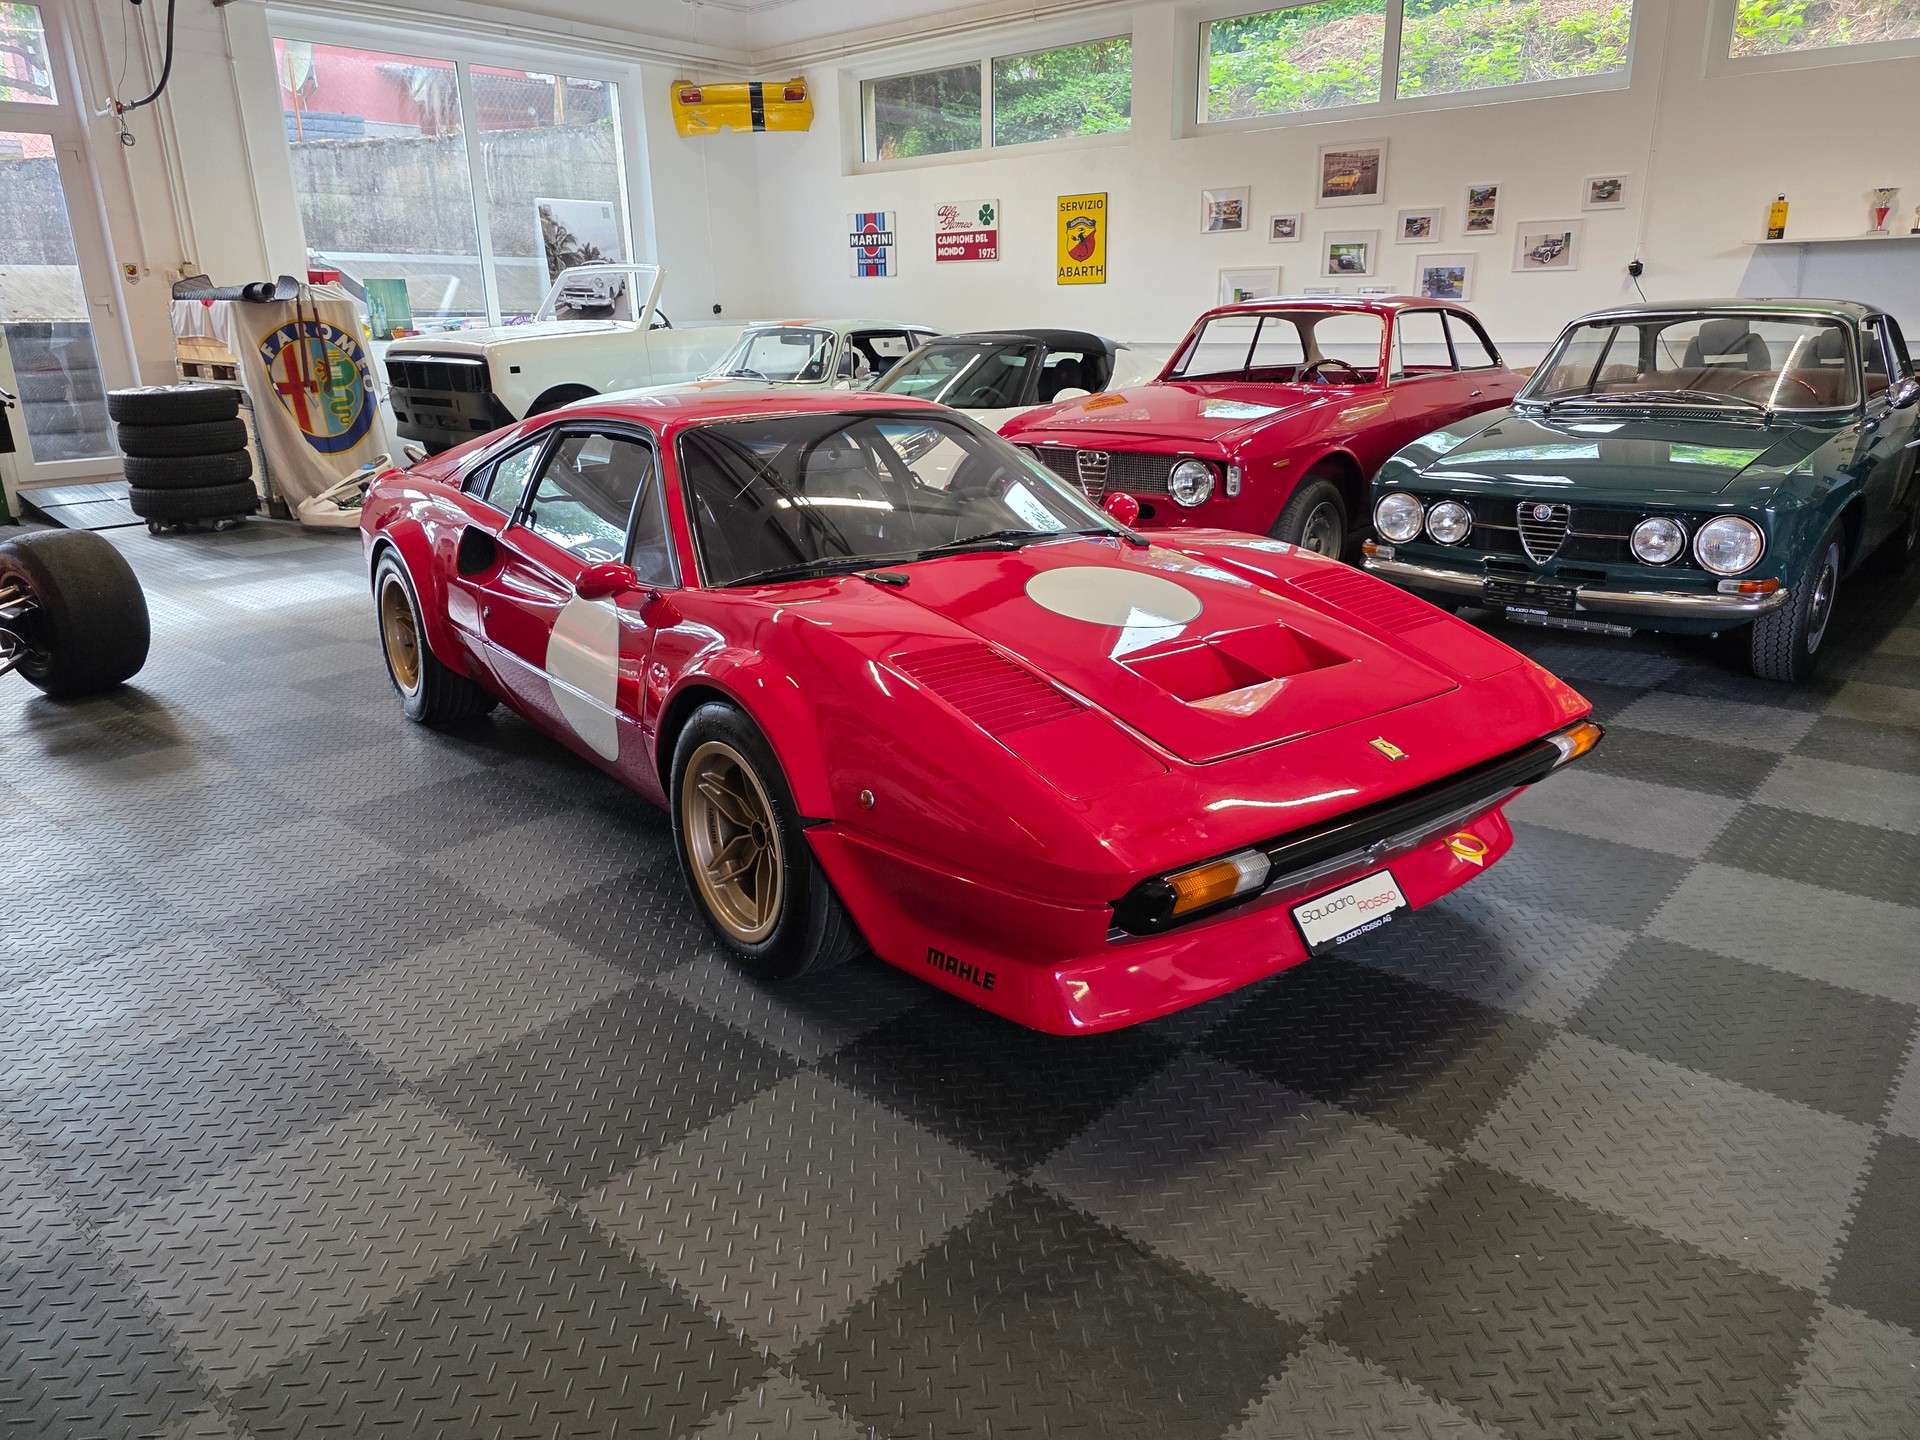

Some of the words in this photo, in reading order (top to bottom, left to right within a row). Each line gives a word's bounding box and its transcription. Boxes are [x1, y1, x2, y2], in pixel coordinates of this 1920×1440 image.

[937, 205, 960, 218] Alfa
[1060, 199, 1104, 212] SERVIZIO
[940, 216, 973, 230] Romeo
[850, 233, 892, 246] MARTINI
[937, 234, 974, 245] CAMPIONE
[975, 233, 989, 243] DEL
[937, 246, 965, 256] MONDO
[978, 247, 996, 259] 1975
[1058, 265, 1104, 278] ABARTH
[1302, 895, 1356, 924] Squadra
[1382, 914, 1392, 924] AG
[927, 947, 995, 991] MAHLE
